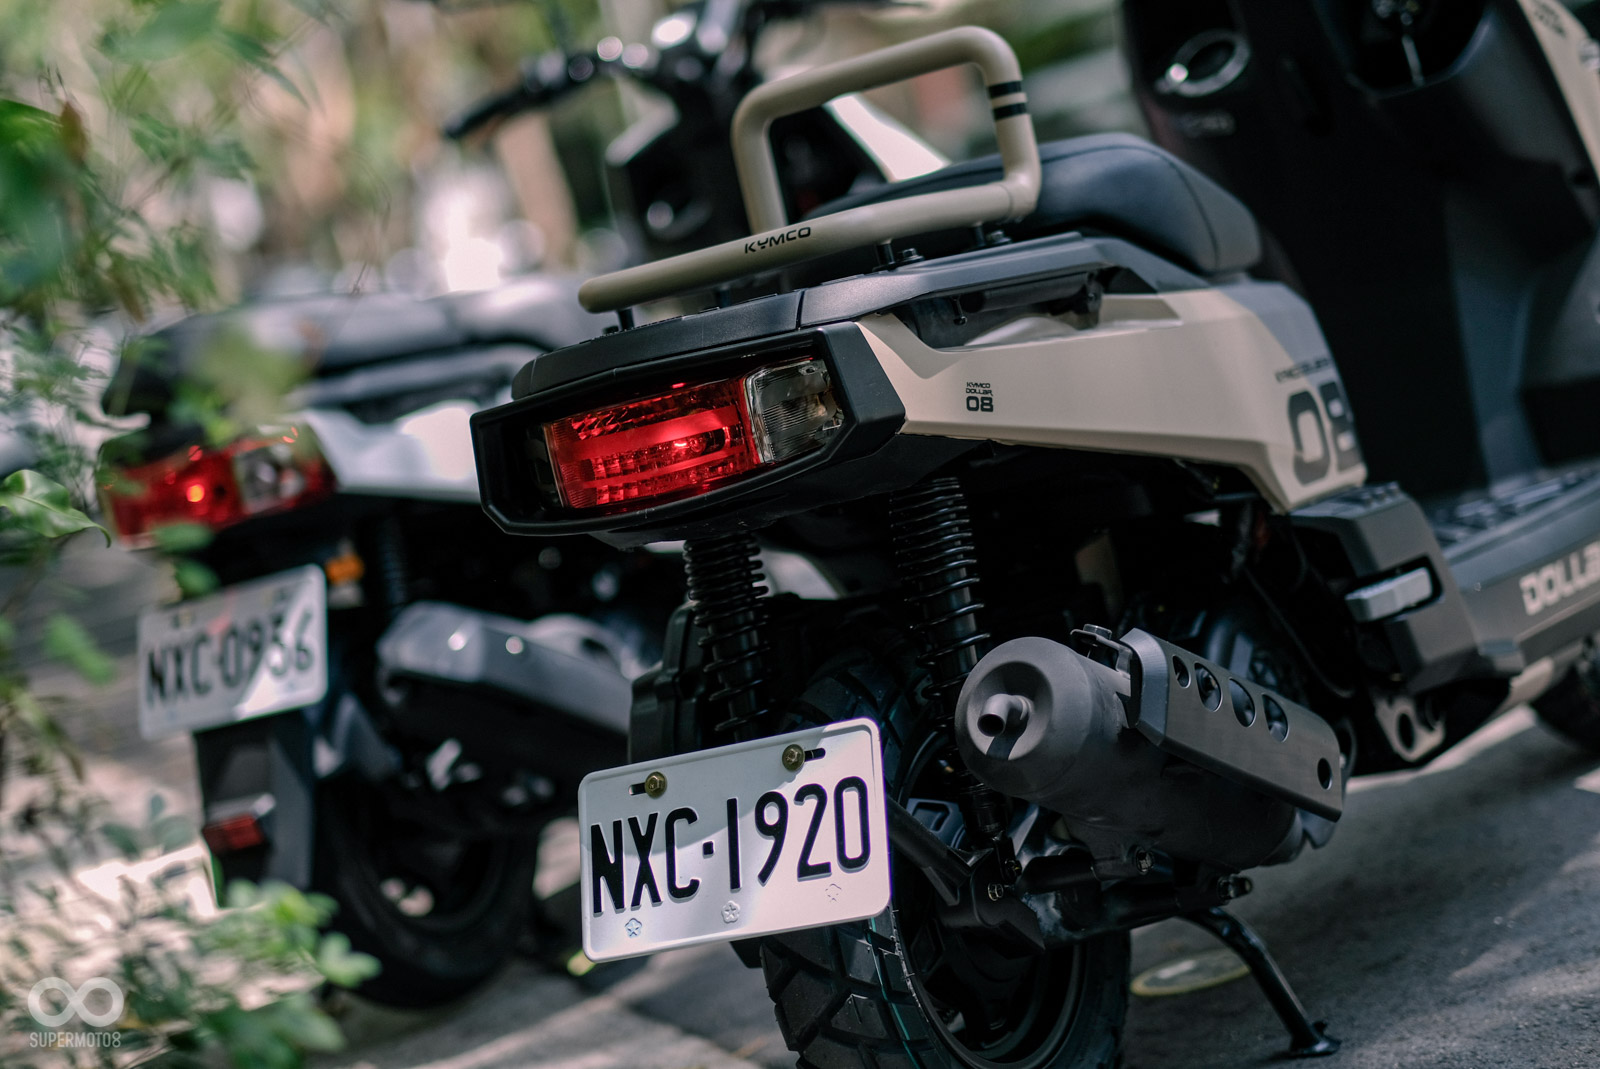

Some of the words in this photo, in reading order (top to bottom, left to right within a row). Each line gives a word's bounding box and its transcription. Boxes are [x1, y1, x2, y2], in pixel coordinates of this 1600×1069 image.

[744, 227, 811, 254] KYMCO
[966, 381, 991, 389] KYMCO
[966, 395, 994, 412] 08
